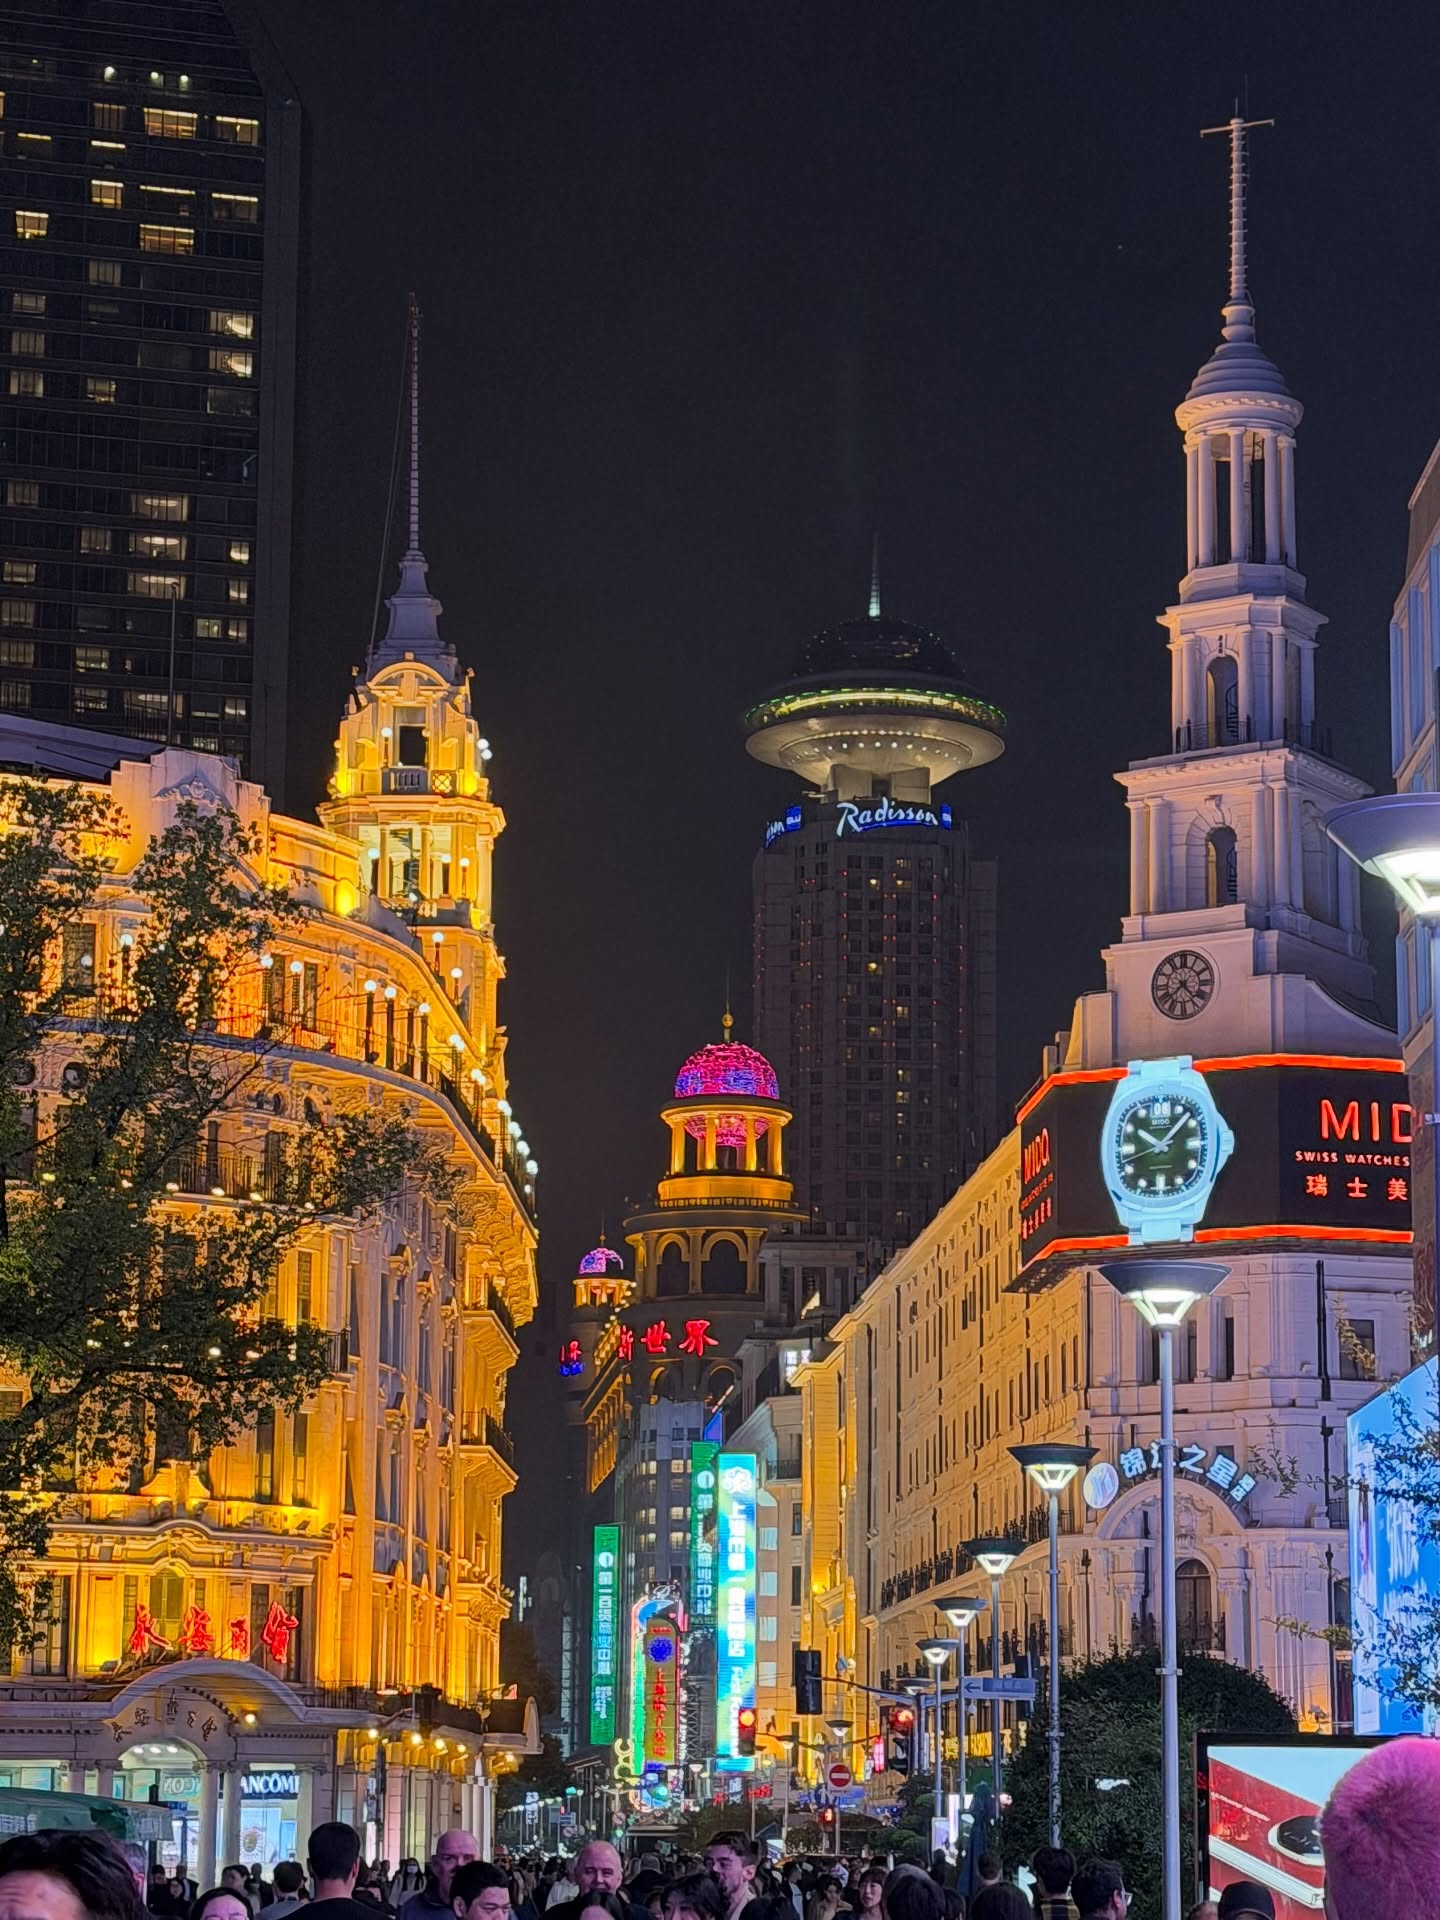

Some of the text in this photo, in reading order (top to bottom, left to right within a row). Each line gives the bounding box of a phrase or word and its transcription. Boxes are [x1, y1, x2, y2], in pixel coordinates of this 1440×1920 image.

[837, 797, 939, 838] Radisson
[1321, 1099, 1414, 1143] MID
[1295, 1150, 1410, 1167] SWISS WATCHES
[1306, 1173, 1408, 1201] 瑞士美
[240, 1772, 300, 1794] ANCÔM
